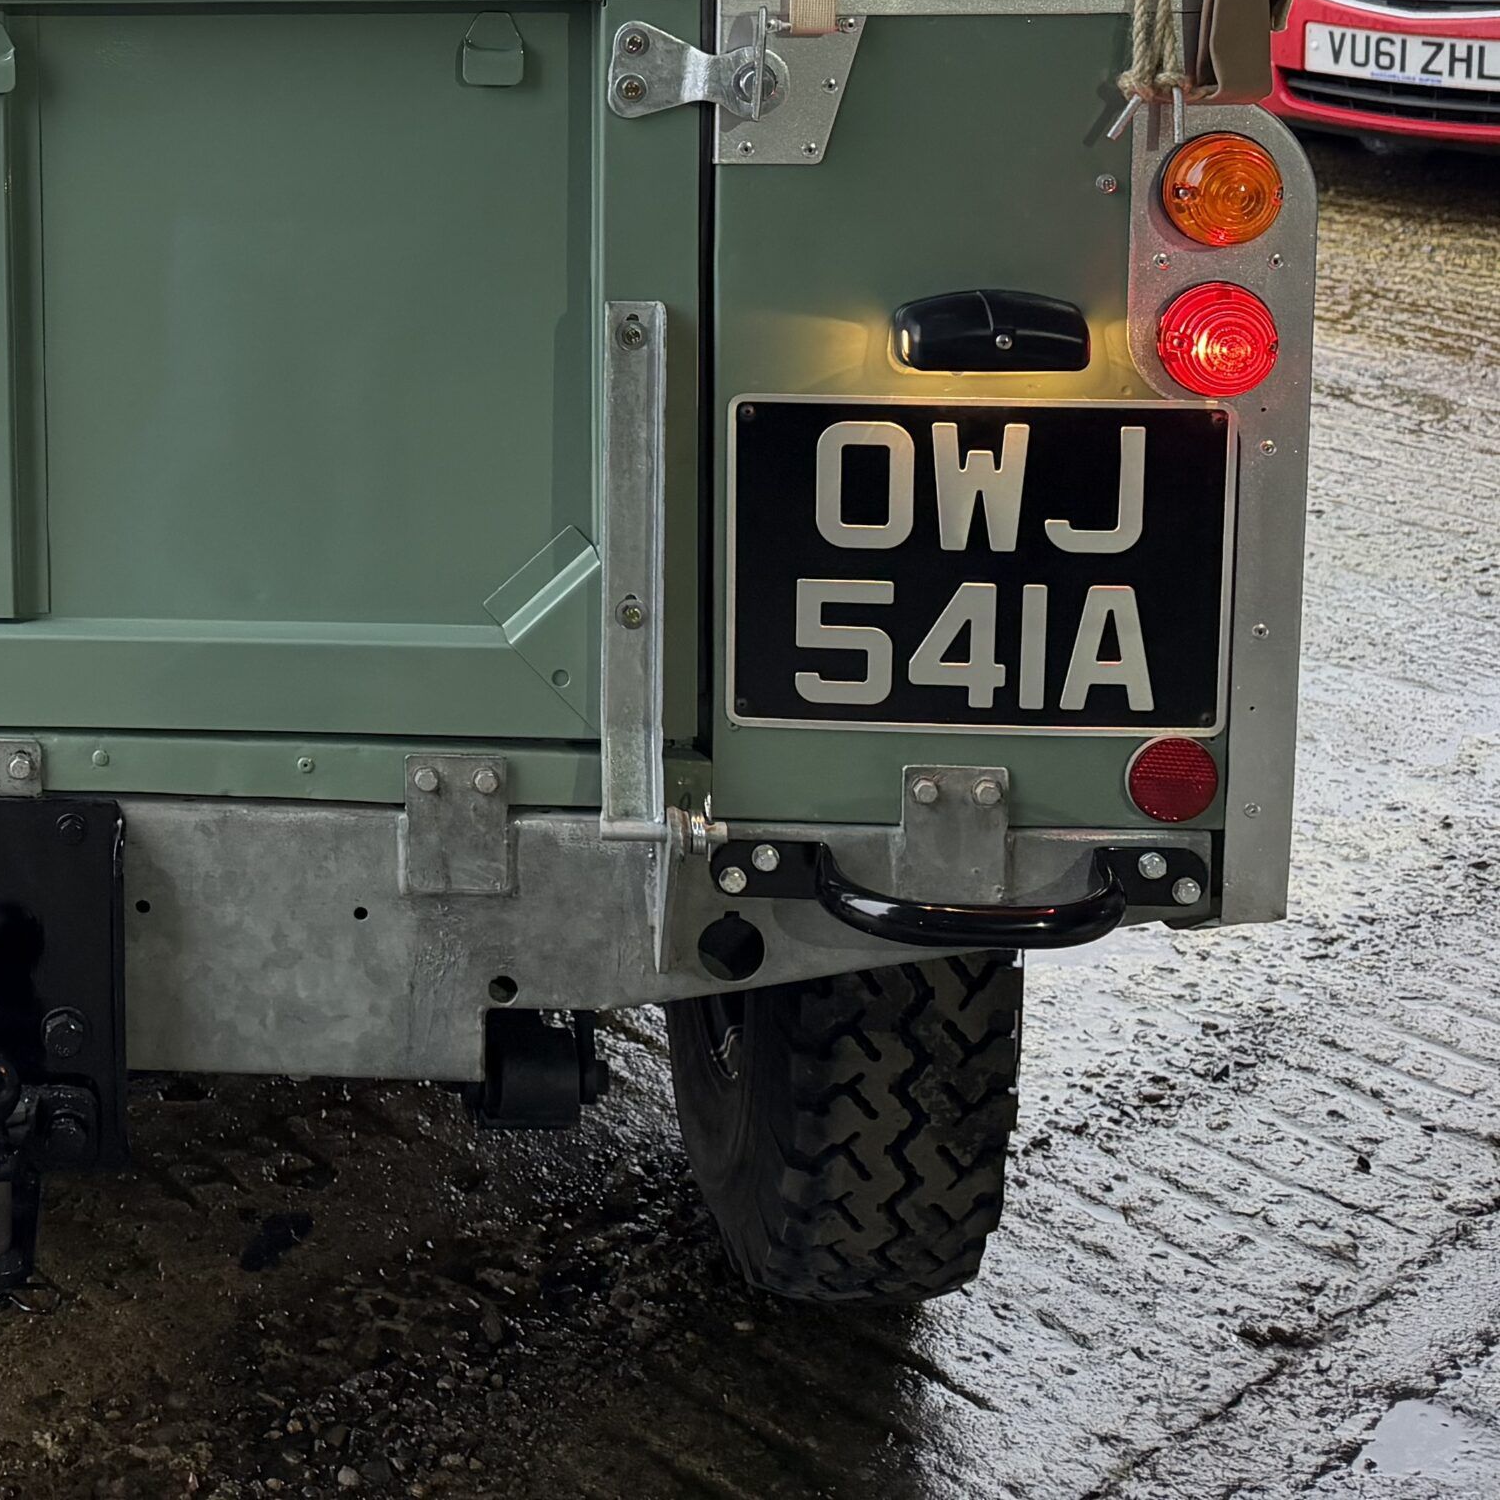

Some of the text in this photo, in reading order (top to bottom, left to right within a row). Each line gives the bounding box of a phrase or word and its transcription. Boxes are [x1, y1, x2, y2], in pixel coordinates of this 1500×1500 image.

[1328, 30, 1500, 80] VU61 ZHL
[815, 420, 1147, 554] OWJ
[795, 578, 1155, 711] 541A
